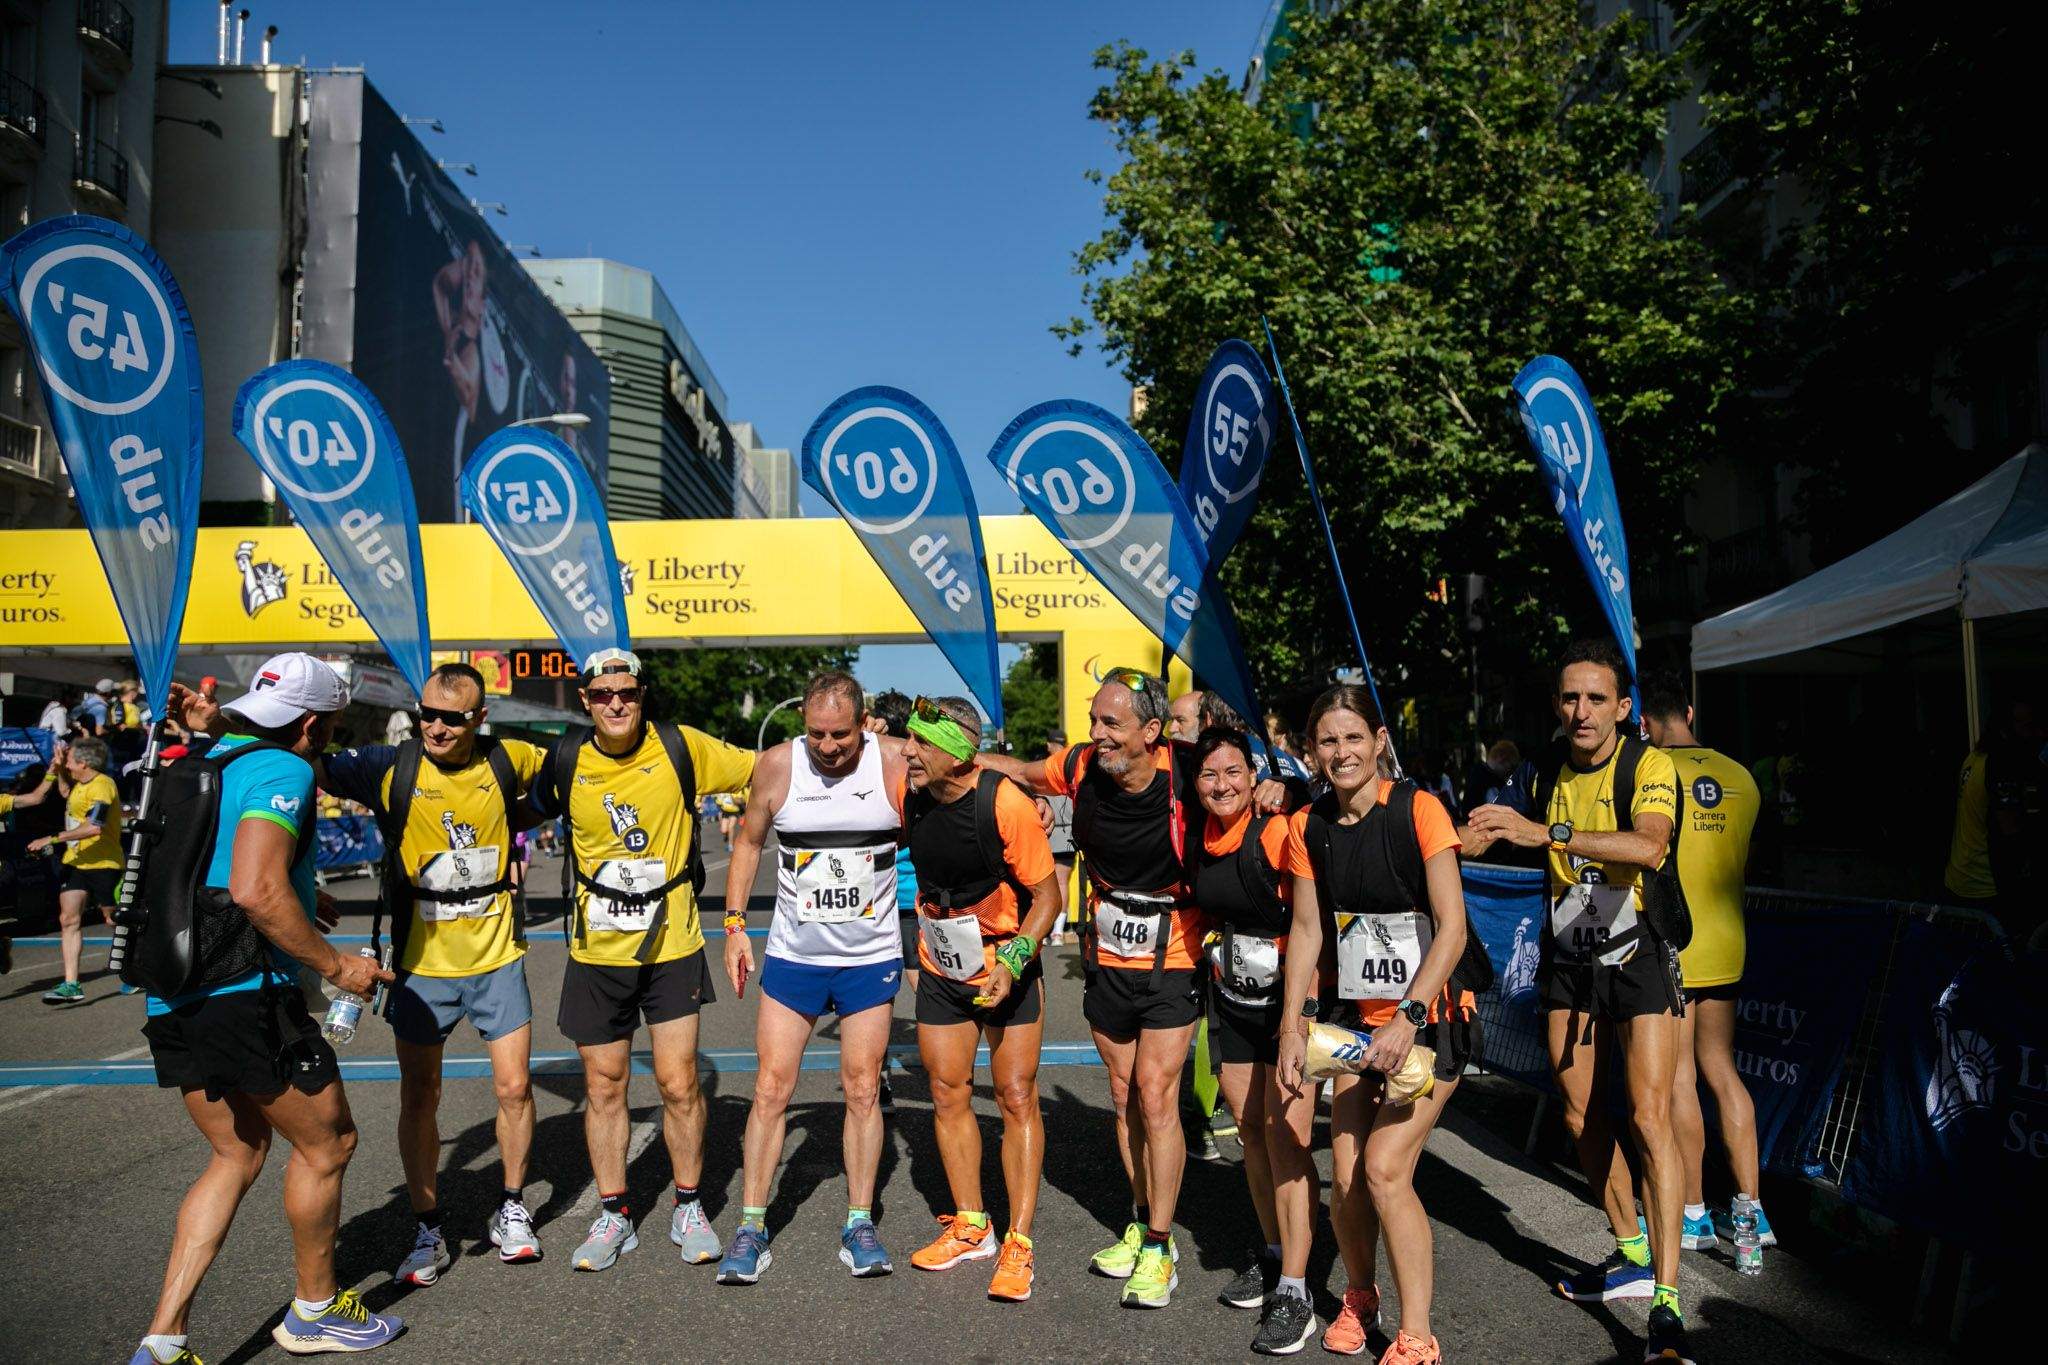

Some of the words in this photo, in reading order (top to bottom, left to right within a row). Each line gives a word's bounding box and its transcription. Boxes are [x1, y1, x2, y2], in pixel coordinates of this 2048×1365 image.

[0, 569, 57, 599] erty
[647, 556, 746, 589] Liberty
[1697, 783, 1717, 801] 13
[1692, 811, 1726, 821] Carrera
[627, 832, 645, 847] 13
[1693, 822, 1726, 834] Liberty
[607, 899, 646, 918] 444
[812, 886, 860, 910] 1458
[1112, 919, 1149, 945] 448
[1572, 926, 1611, 949] 443
[933, 947, 963, 970] 451
[1361, 958, 1407, 984] 449
[1735, 1048, 1800, 1088] uros
